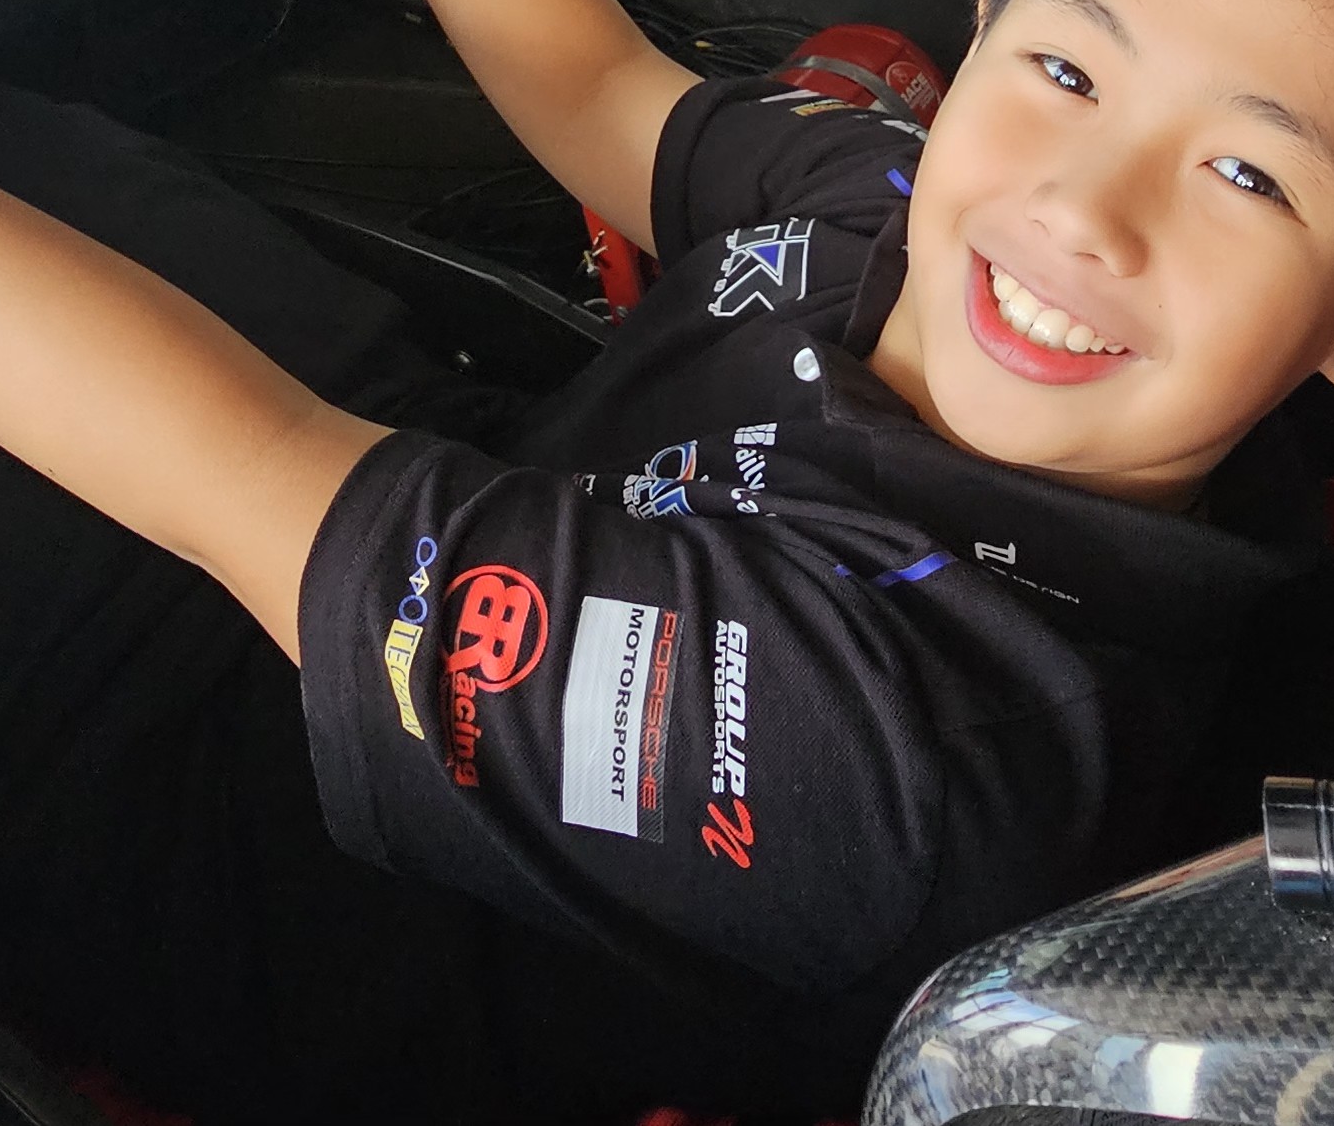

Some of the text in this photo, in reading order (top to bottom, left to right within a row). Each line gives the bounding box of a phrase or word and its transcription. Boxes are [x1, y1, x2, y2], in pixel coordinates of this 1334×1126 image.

[610, 607, 645, 803] MOTORSPORT
[640, 610, 678, 810] PORSCHE
[710, 619, 728, 794] AUTOSPORTS
[724, 620, 749, 797] GROUP
